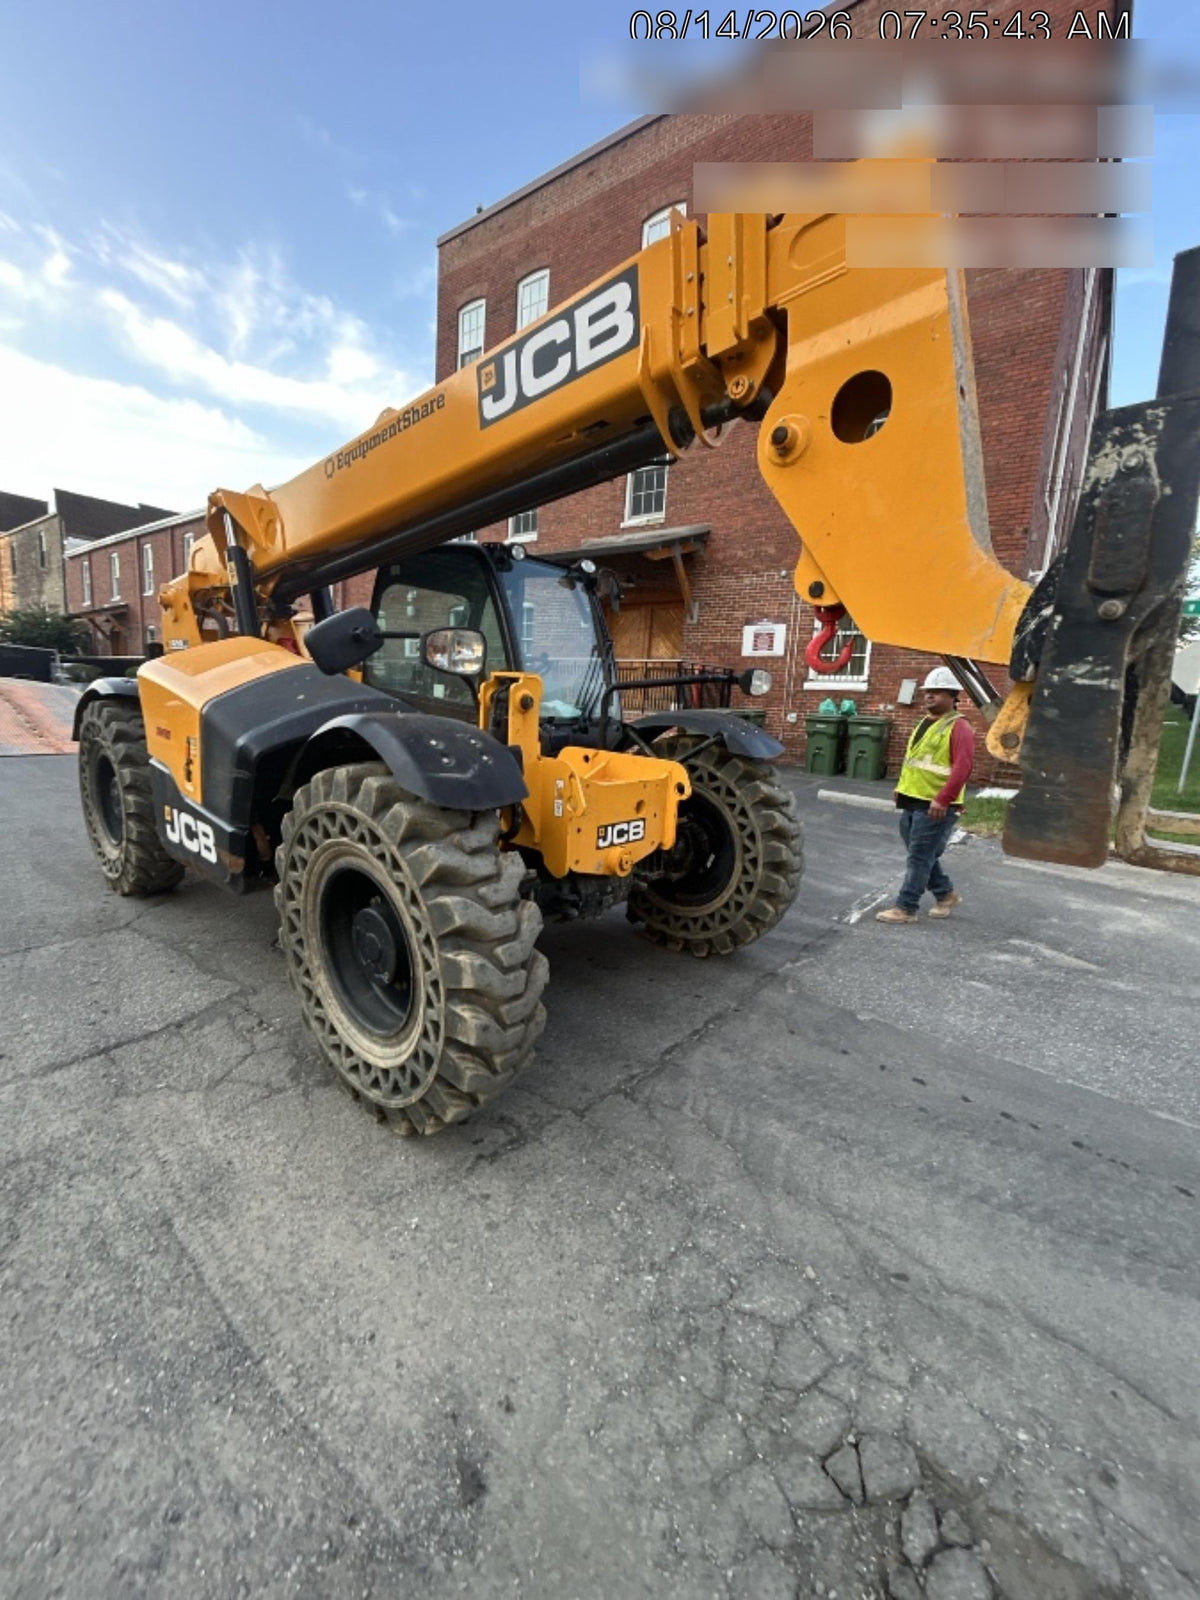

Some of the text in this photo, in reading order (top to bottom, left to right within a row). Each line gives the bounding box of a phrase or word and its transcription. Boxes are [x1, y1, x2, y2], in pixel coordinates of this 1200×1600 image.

[481, 282, 635, 420] JCB
[336, 393, 446, 470] EquipmentShare
[166, 809, 217, 864] JCB
[598, 820, 645, 848] JCB
